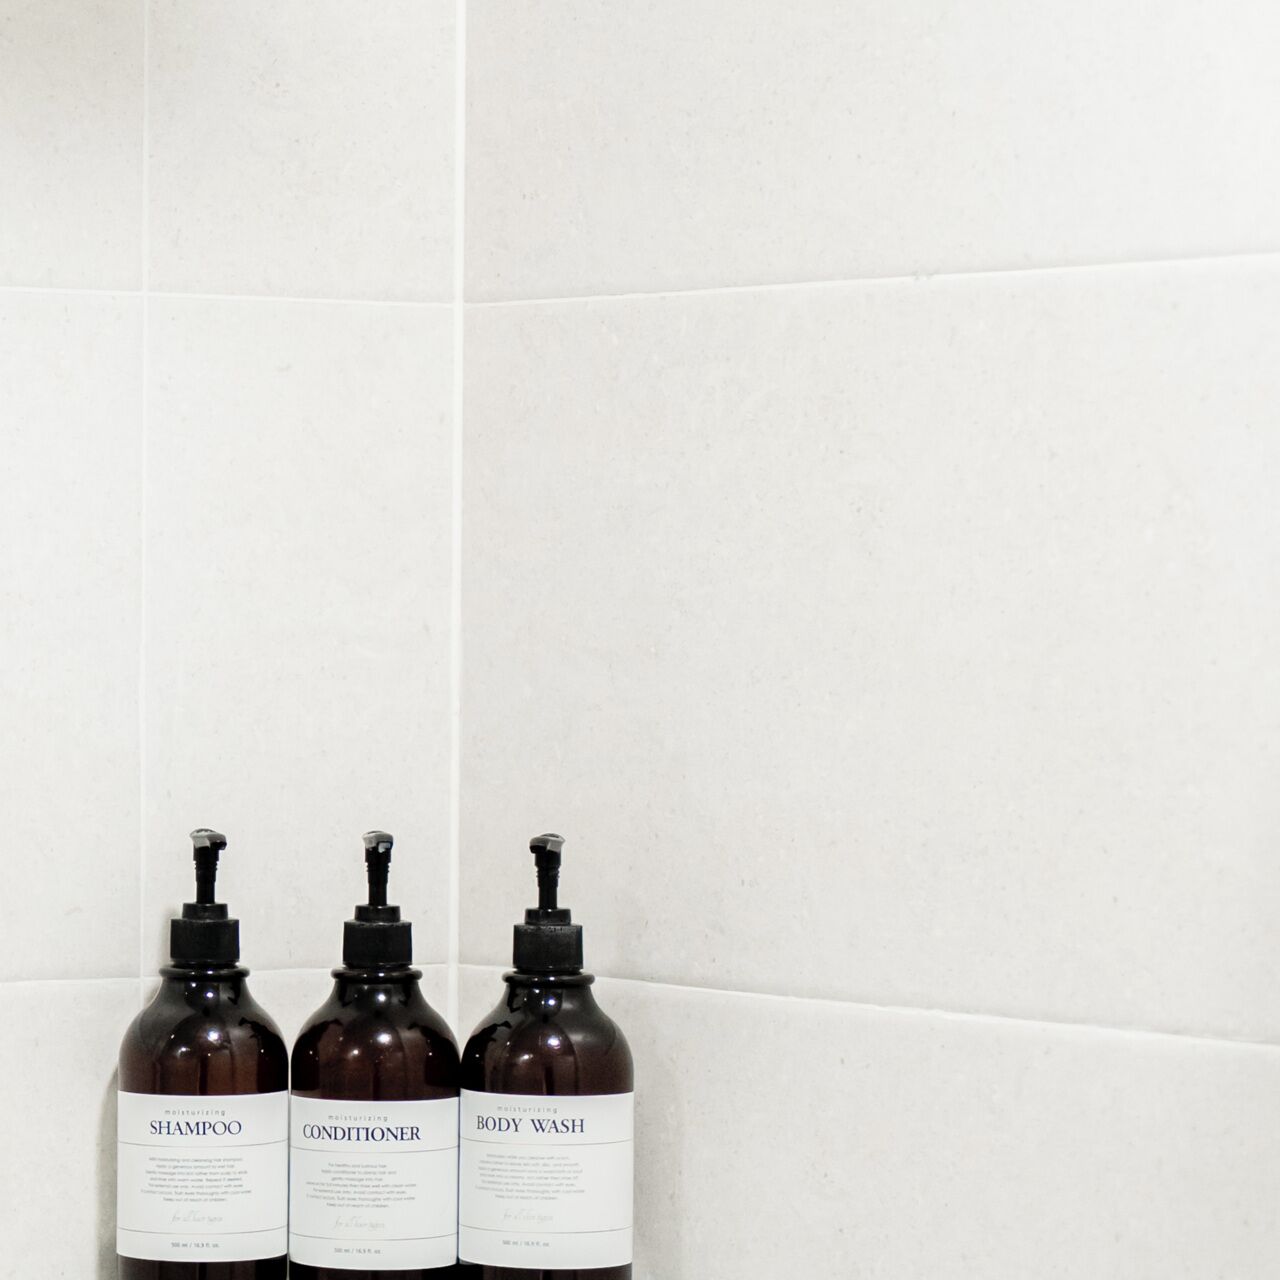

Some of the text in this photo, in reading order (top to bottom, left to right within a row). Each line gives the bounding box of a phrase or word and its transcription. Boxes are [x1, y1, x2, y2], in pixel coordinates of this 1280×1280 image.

[150, 1120, 242, 1136] SHAMPOO
[303, 1123, 421, 1142] CONDITIONER
[477, 1115, 585, 1134] BODY WASH
